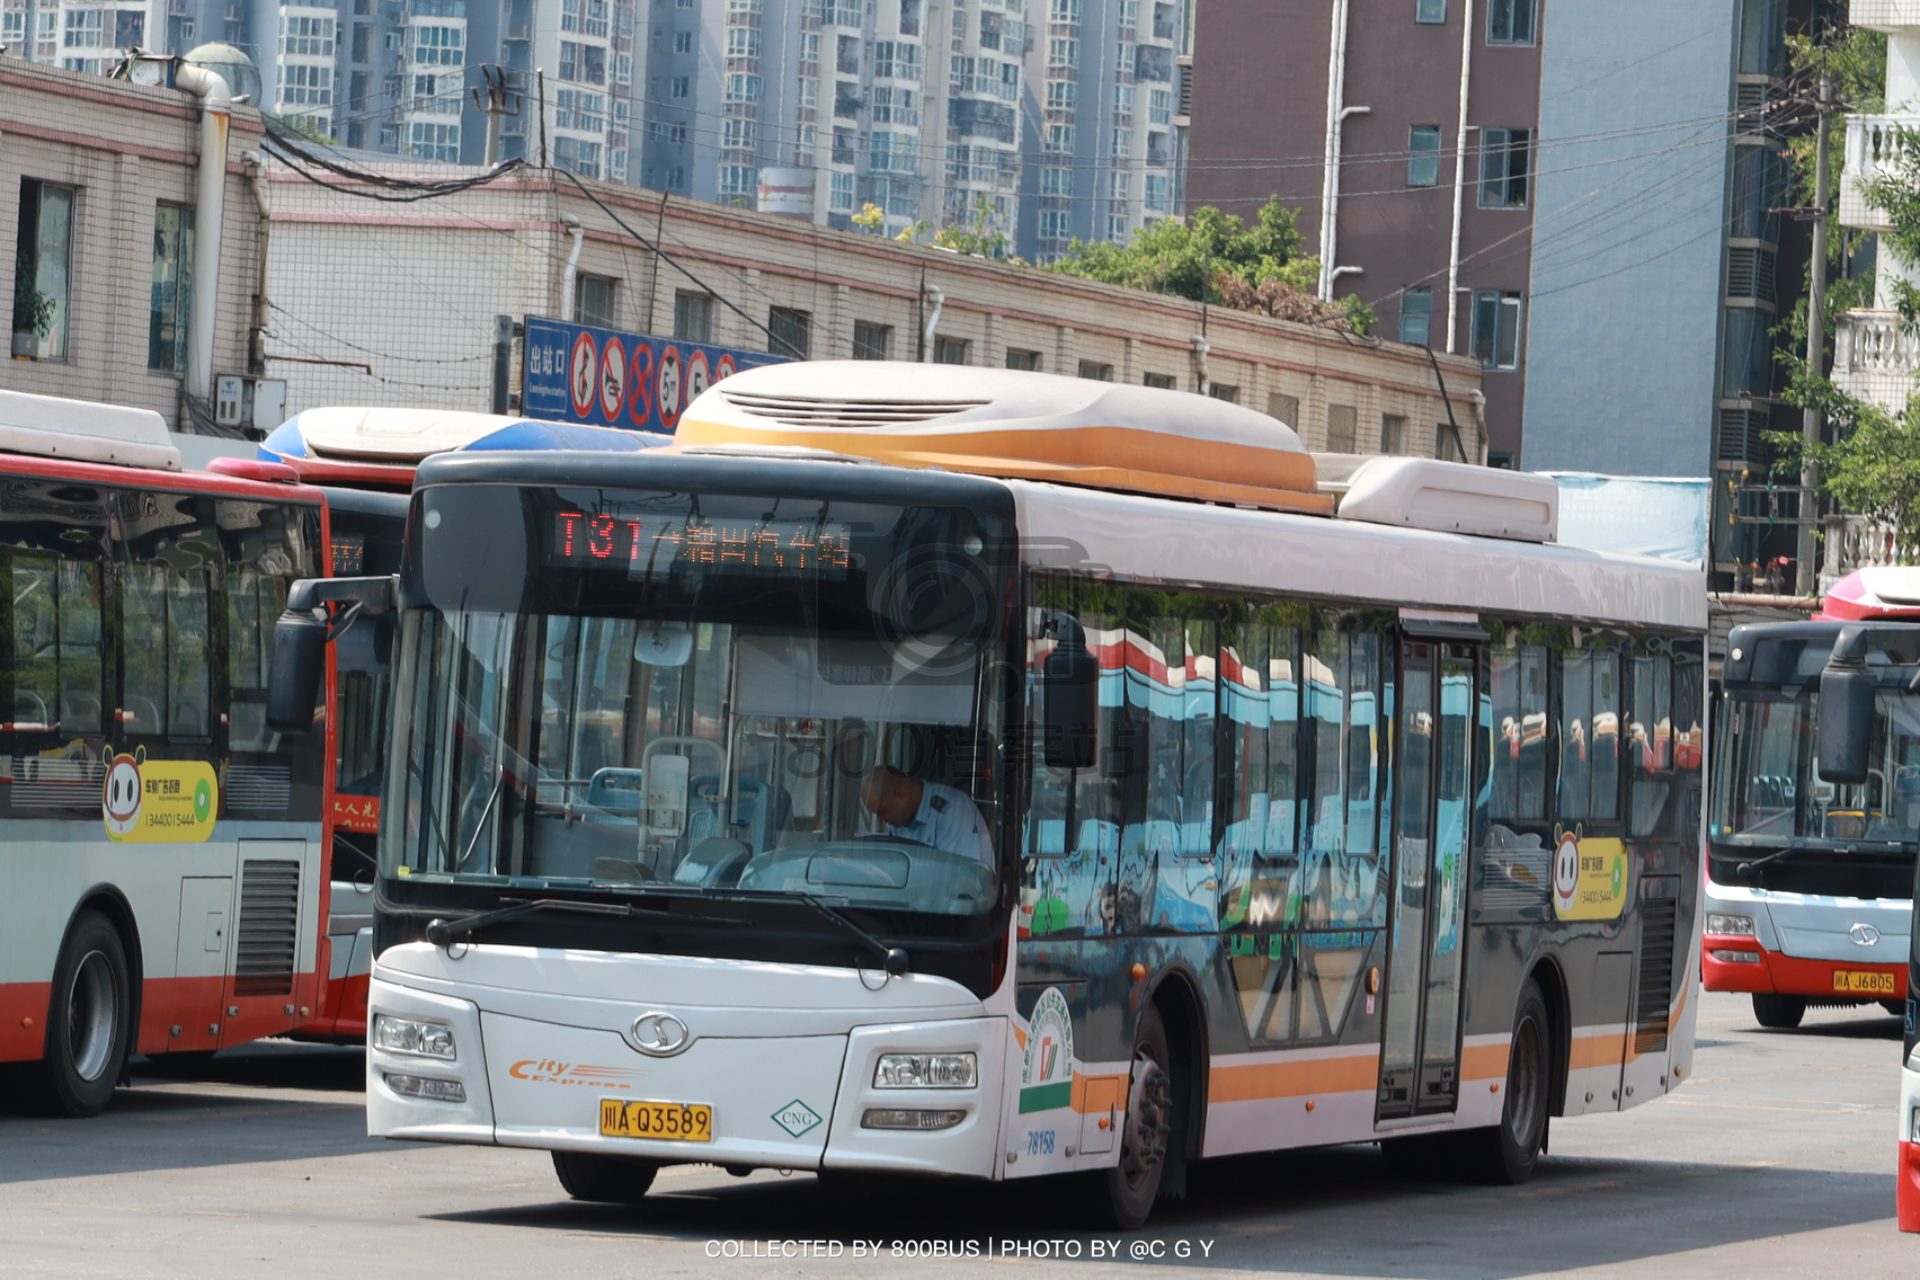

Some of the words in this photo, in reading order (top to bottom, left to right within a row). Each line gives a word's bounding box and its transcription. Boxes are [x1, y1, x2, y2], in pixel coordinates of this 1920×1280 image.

[530, 344, 565, 376] 出站口
[509, 1058, 570, 1079] City
[532, 1074, 631, 1089] Express
[782, 1110, 812, 1126] CNG
[1028, 1129, 1056, 1156] 78158
